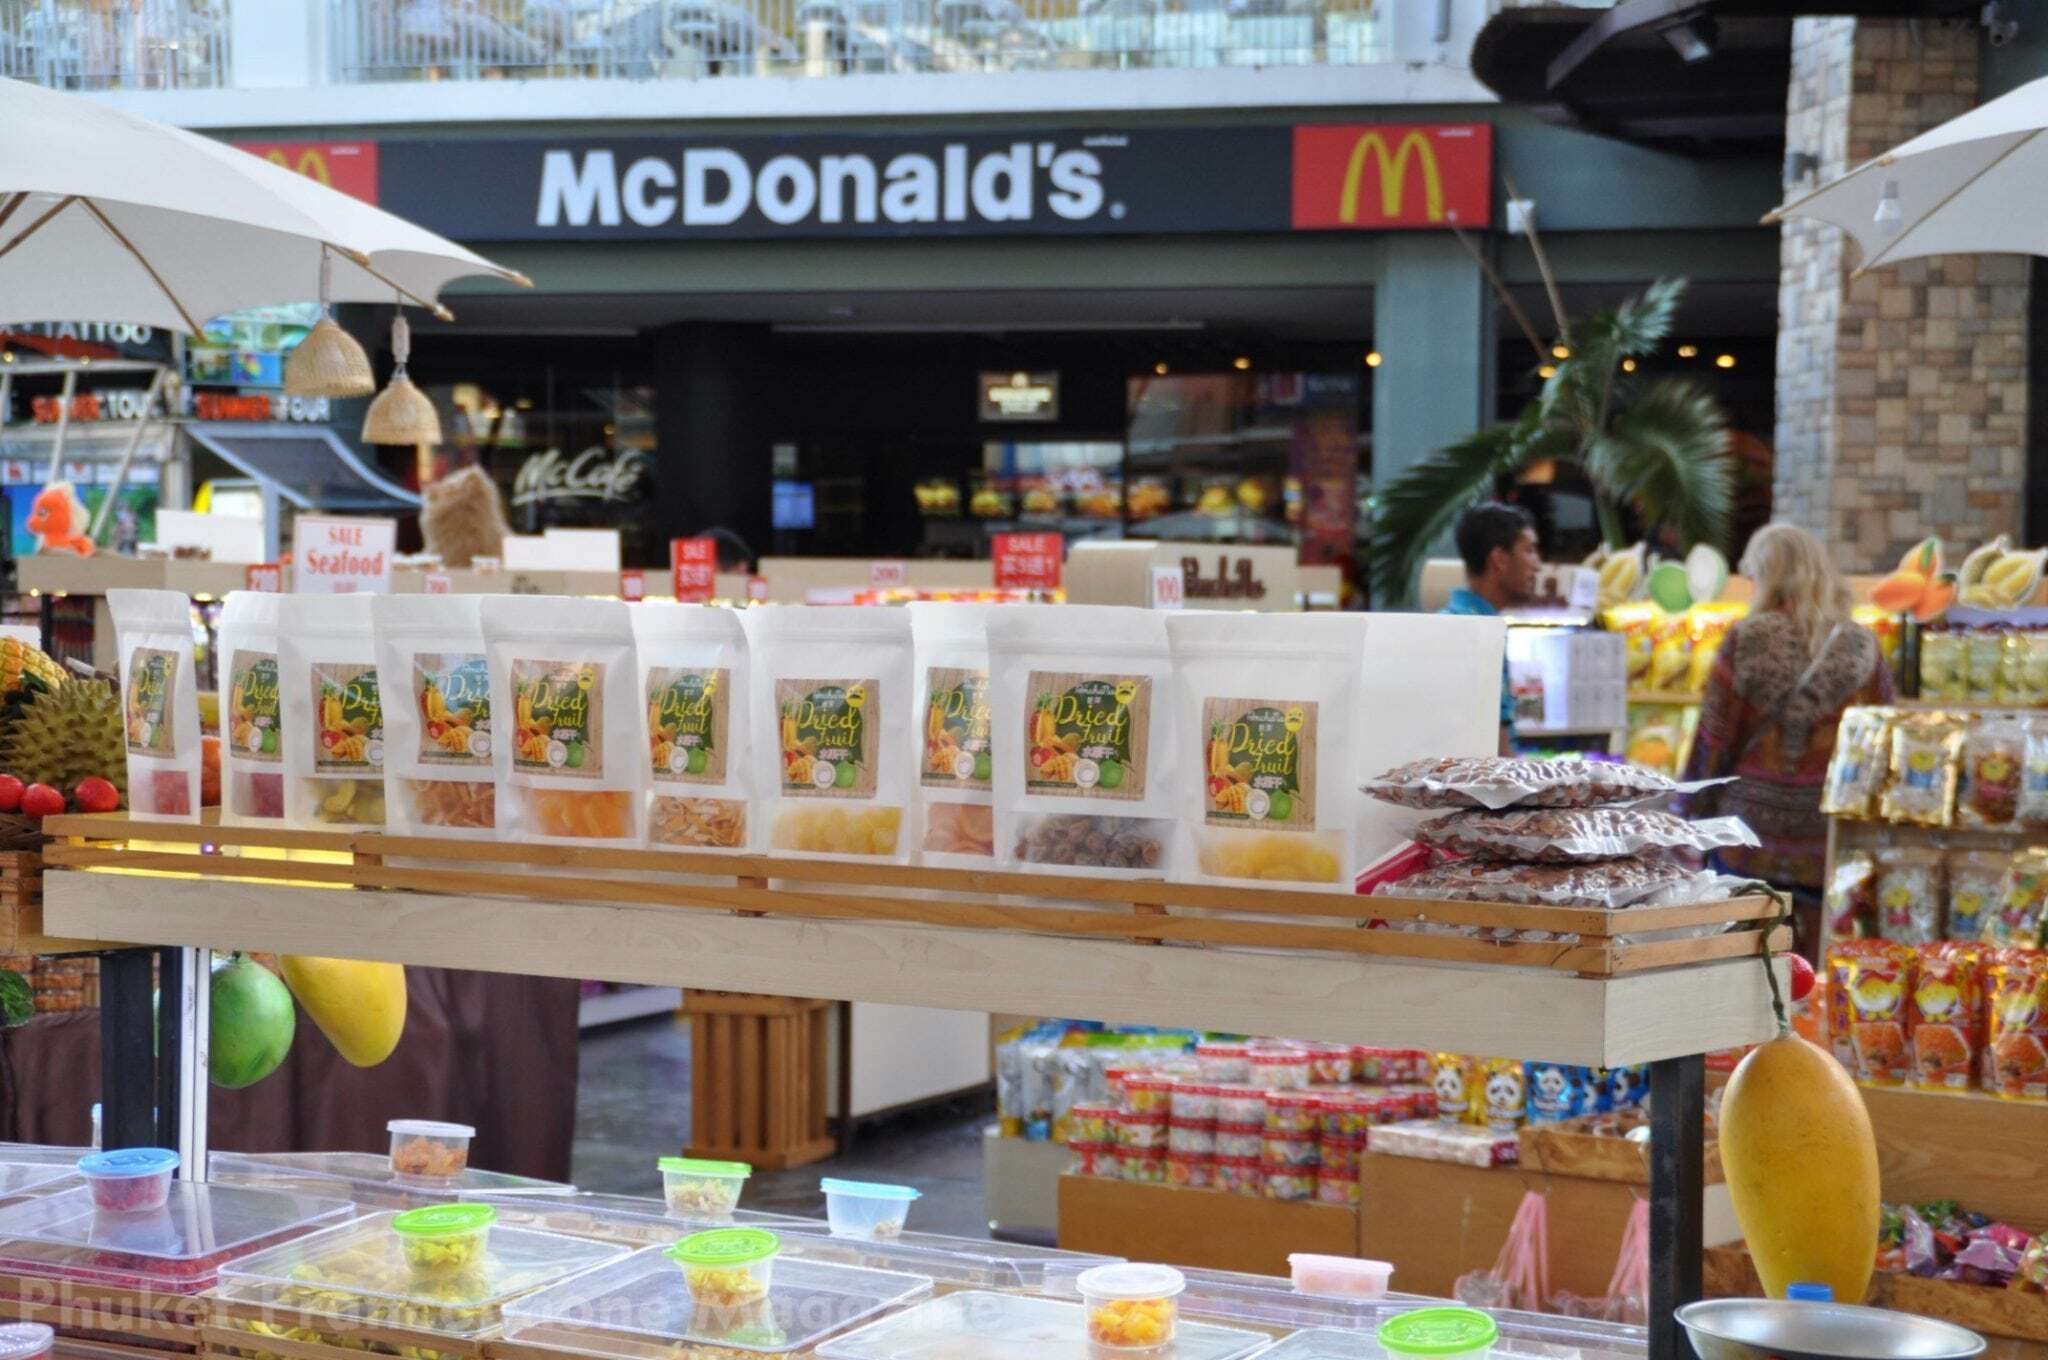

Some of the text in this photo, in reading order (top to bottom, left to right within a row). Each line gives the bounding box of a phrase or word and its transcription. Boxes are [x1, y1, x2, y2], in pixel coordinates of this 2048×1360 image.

[536, 142, 1104, 227] McDonald's
[327, 527, 364, 547] SALE
[1008, 536, 1045, 551] SALE
[306, 551, 384, 576] Seafood
[531, 680, 588, 711] Dried
[661, 688, 712, 717] Dried
[796, 700, 860, 730] Dried
[1055, 695, 1128, 727] Dried
[1228, 722, 1296, 756] Dried
